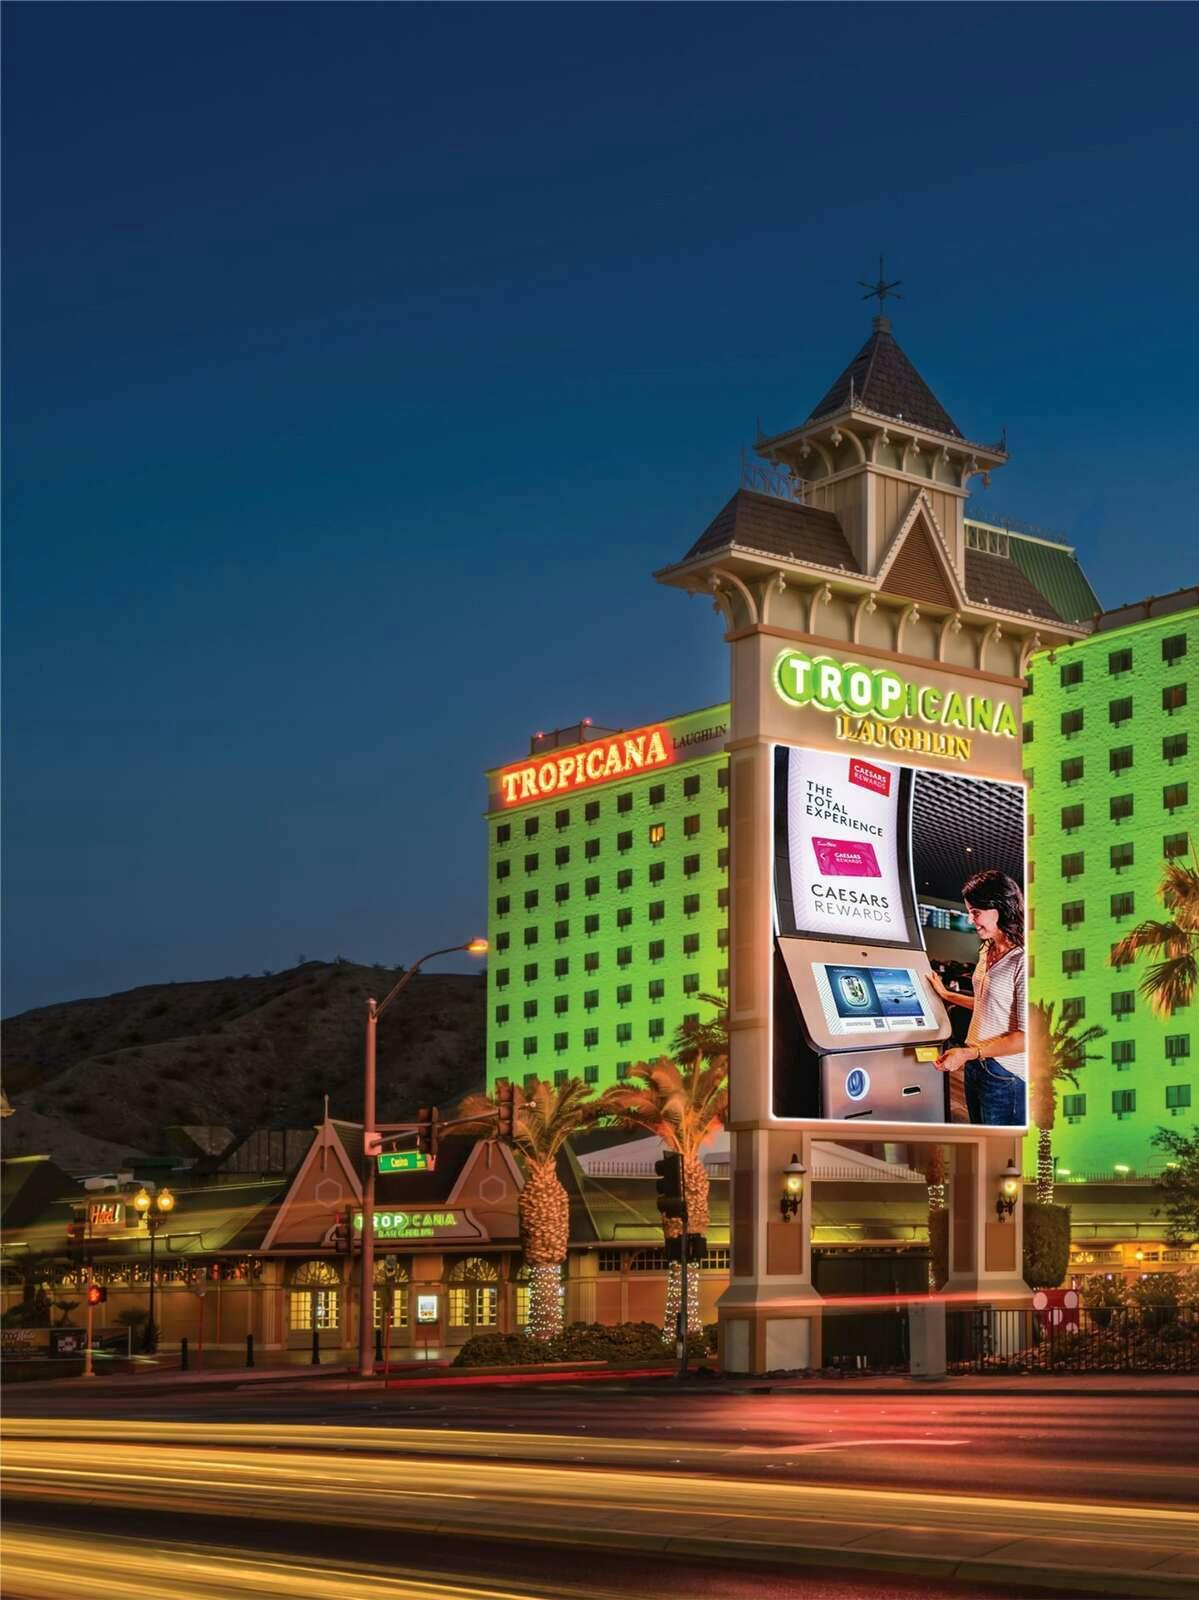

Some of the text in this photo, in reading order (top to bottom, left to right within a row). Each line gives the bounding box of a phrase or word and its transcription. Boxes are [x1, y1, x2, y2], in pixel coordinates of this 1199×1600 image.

[786, 657, 1020, 738] TROPICANA
[672, 723, 728, 750] LAUGHLIN
[836, 714, 973, 762] LAUGHLIN
[502, 731, 668, 802] TROPICANA
[853, 764, 887, 783] CAESARS
[806, 780, 833, 798] THE
[853, 771, 887, 790] REWARDS
[806, 792, 849, 815] TOTAL
[806, 804, 884, 837] EXPERIENCE
[834, 852, 861, 860] CAESARS
[811, 884, 889, 909] CAESARS
[814, 900, 892, 923] REWARDS
